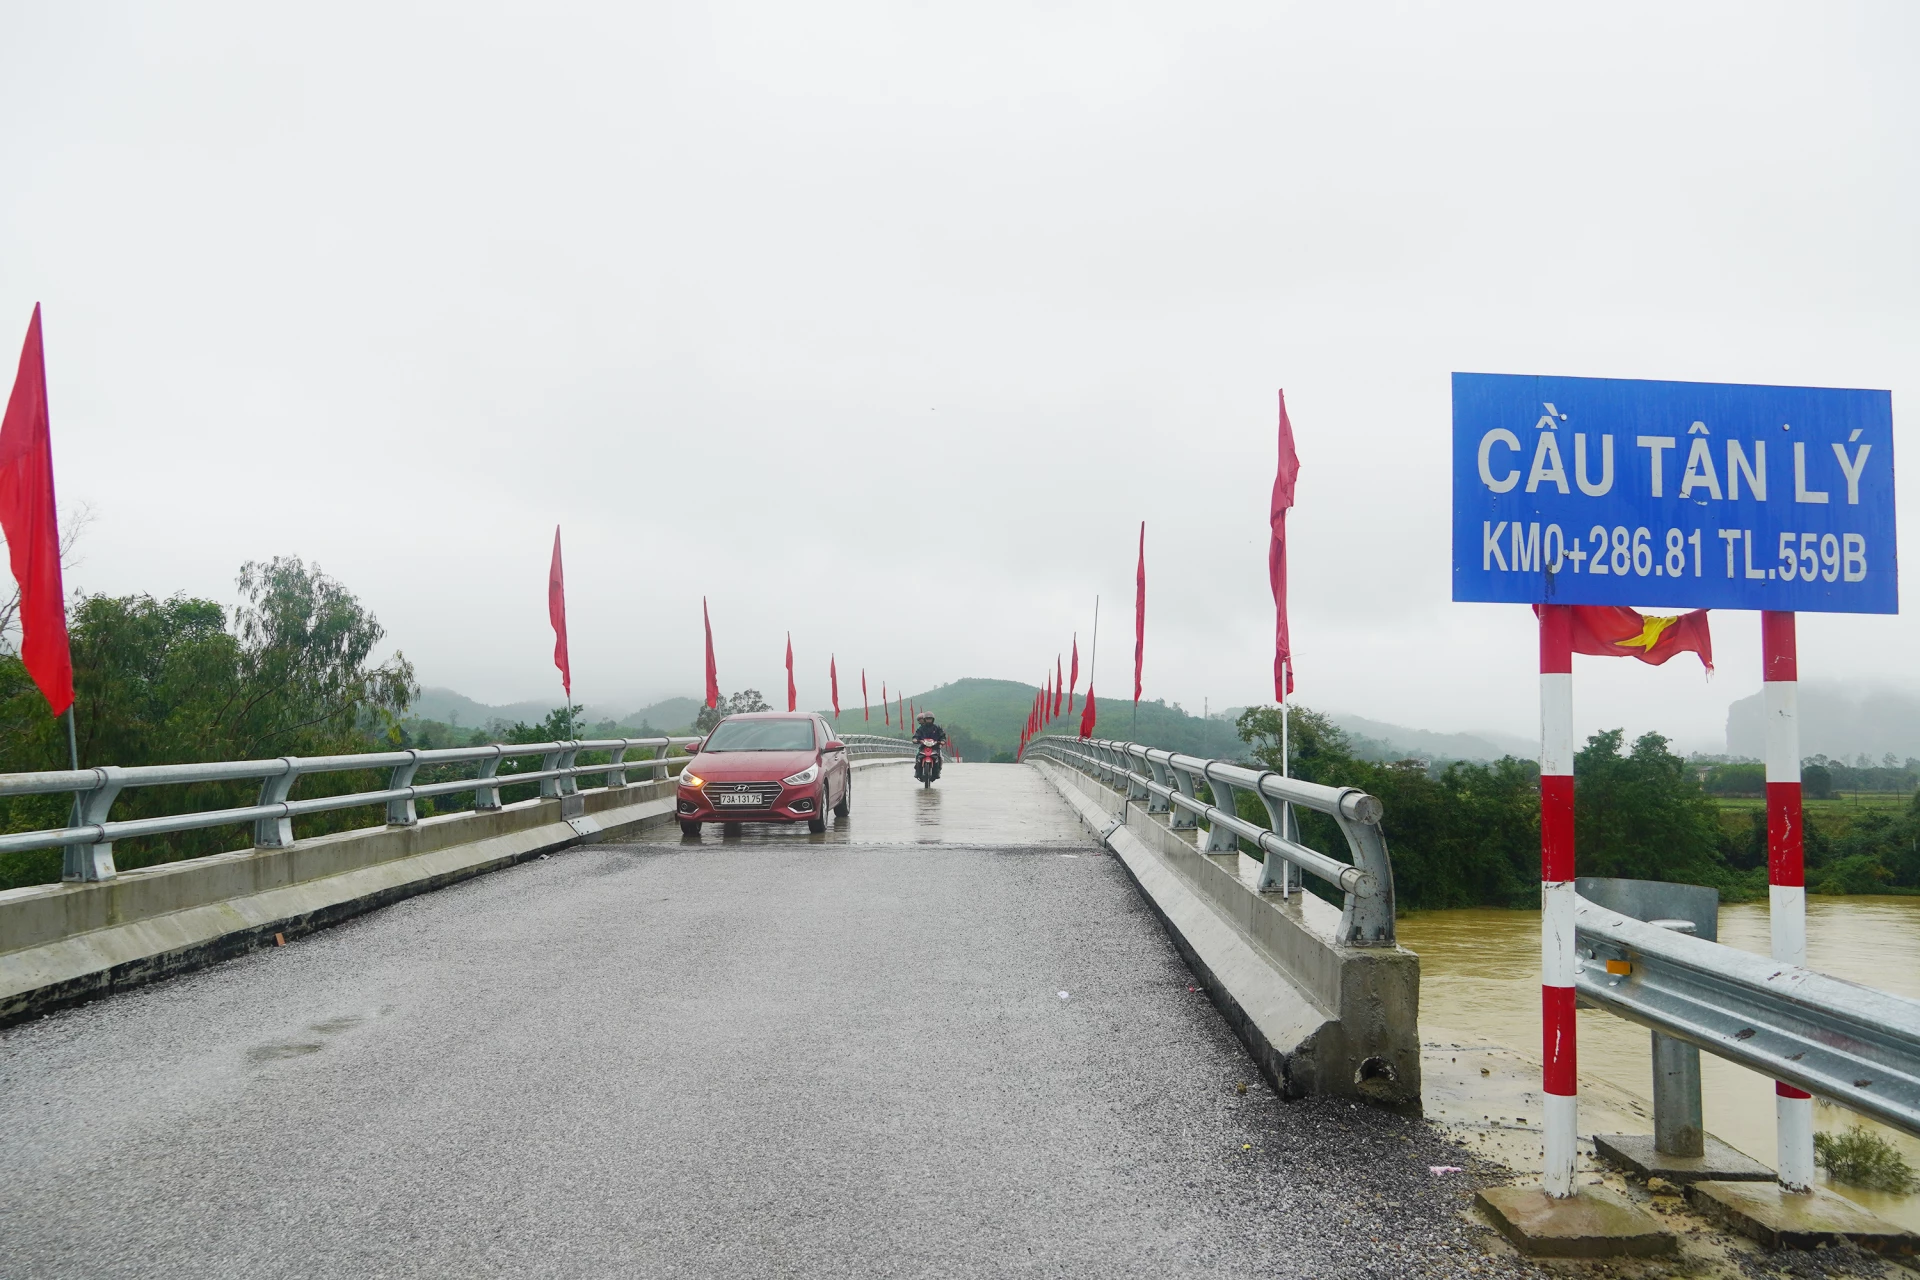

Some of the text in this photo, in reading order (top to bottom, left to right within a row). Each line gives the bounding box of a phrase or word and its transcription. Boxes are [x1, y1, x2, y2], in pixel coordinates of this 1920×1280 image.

[1477, 402, 1872, 505] CẦU TÂN LÝ
[1483, 520, 1867, 582] KM0+286.81 TL.559B
